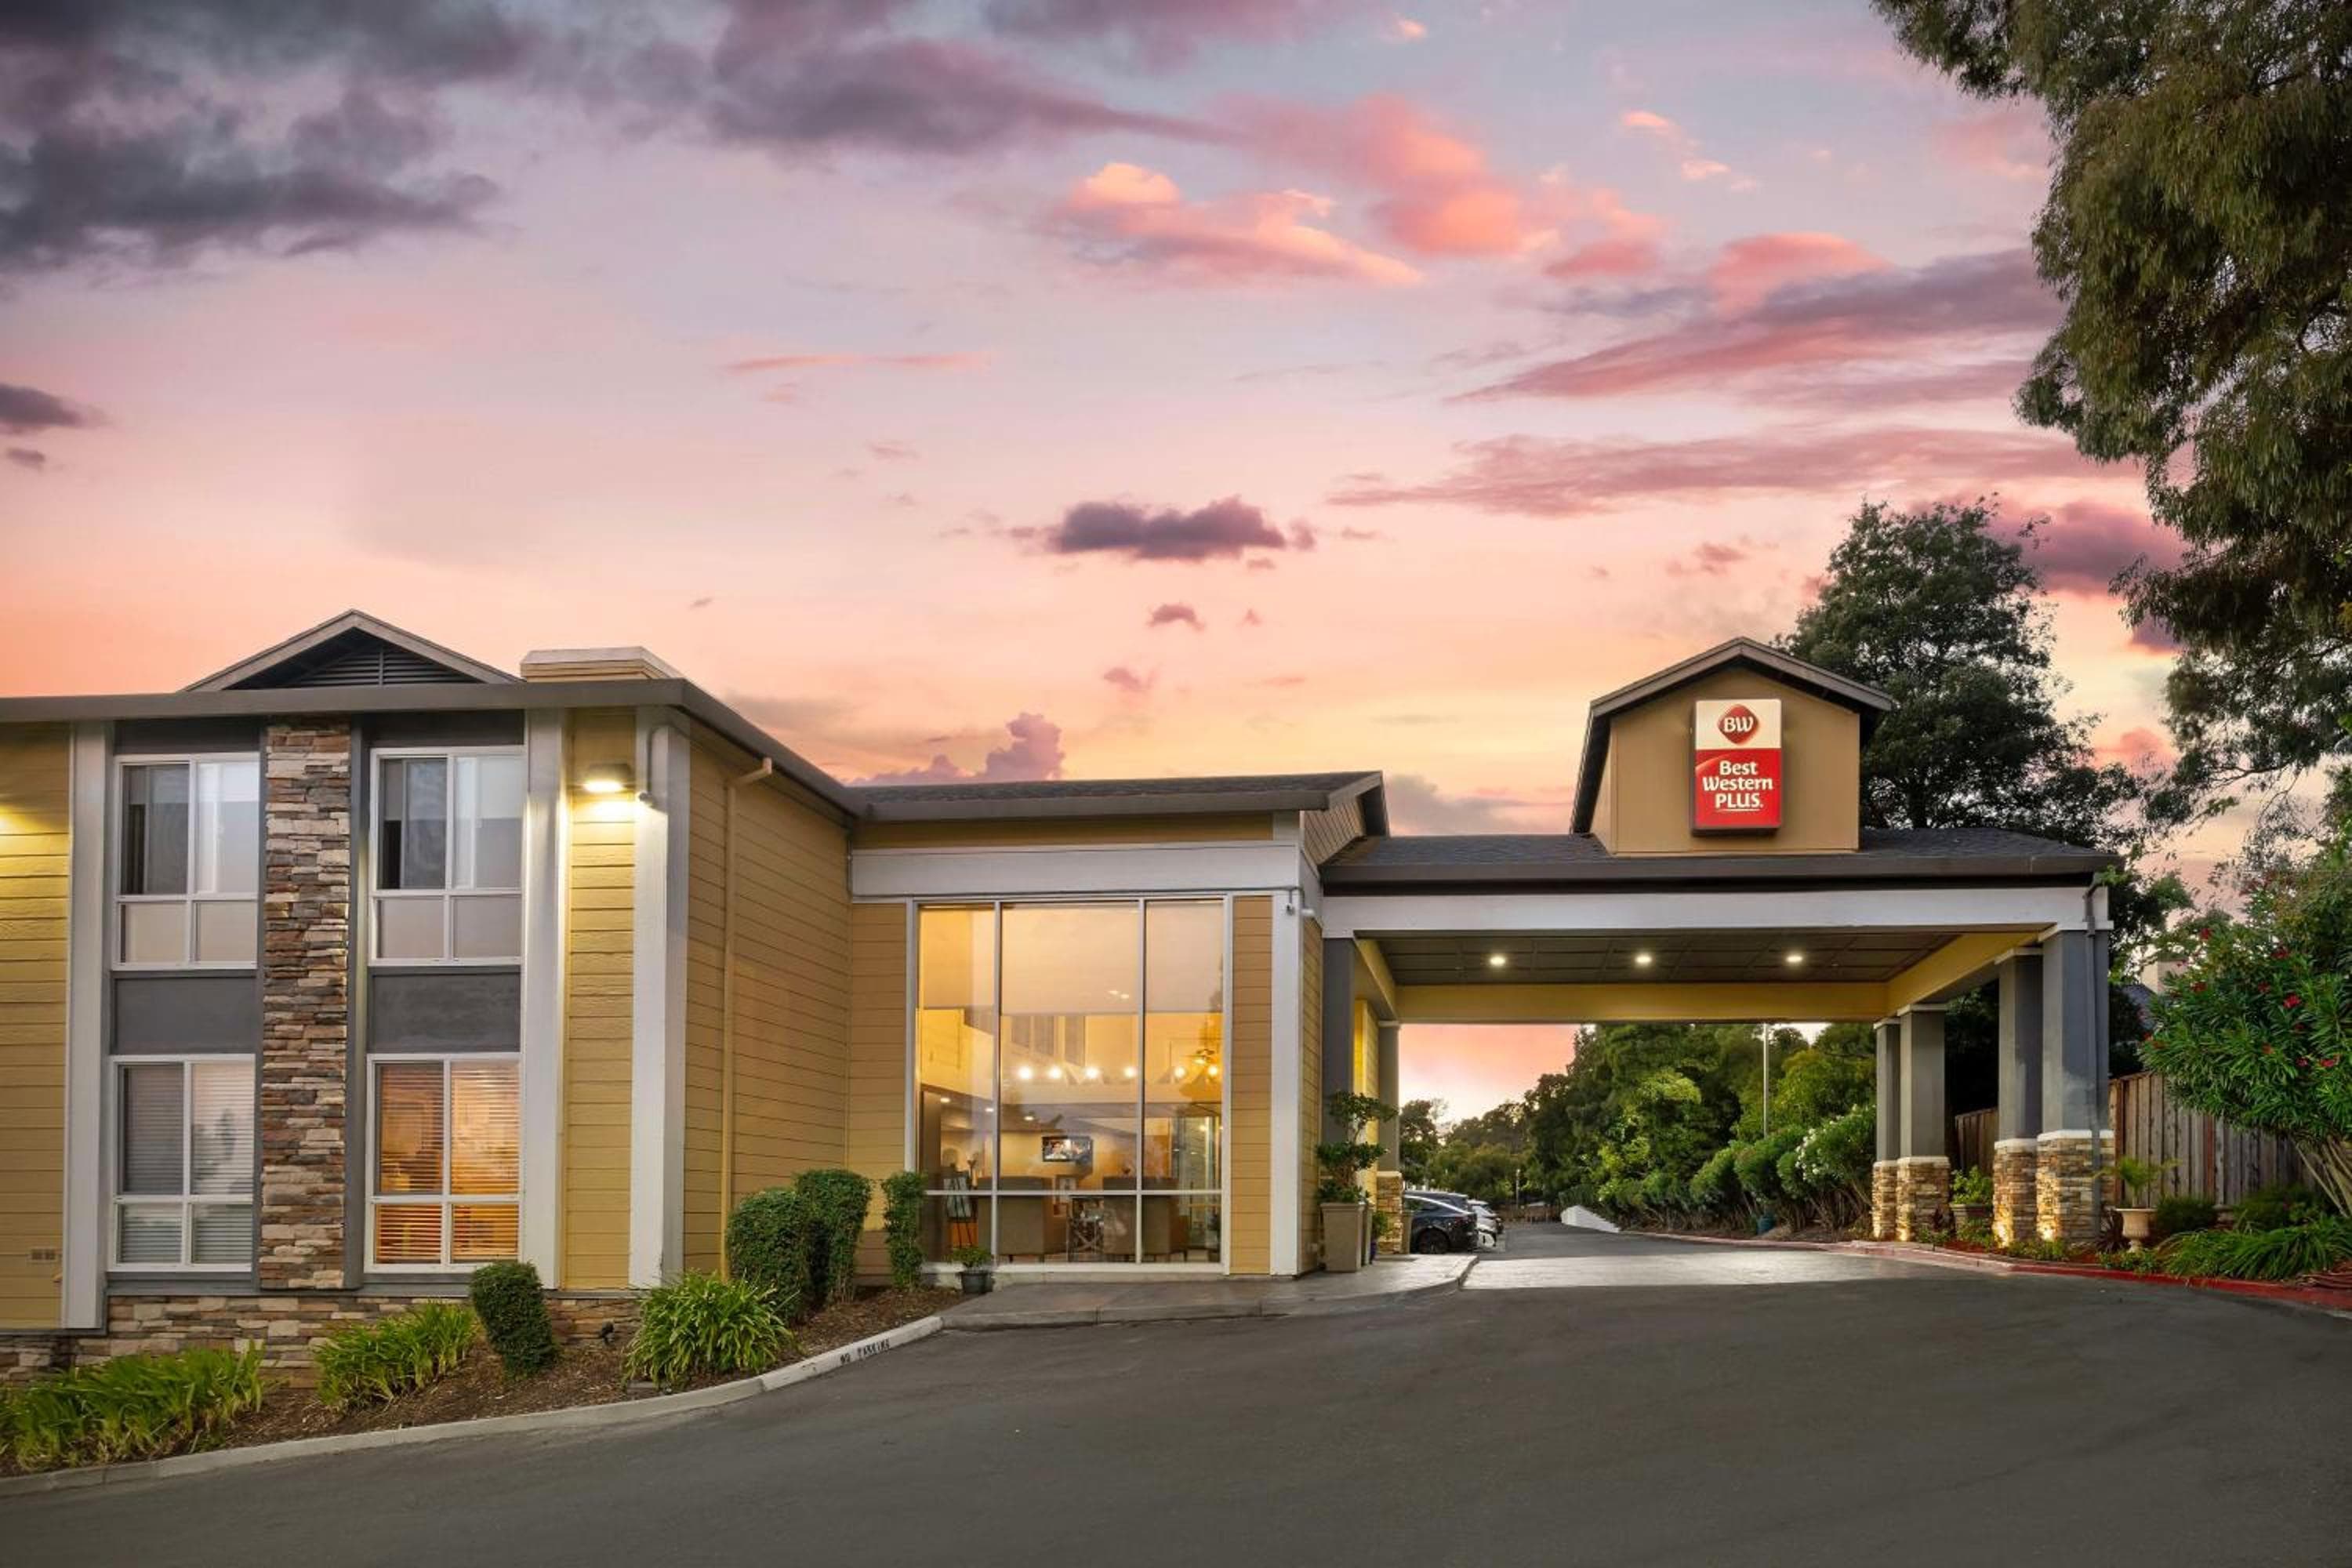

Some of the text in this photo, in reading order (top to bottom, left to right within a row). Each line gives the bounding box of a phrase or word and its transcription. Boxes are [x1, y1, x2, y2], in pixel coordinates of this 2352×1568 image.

[1723, 717, 1754, 732] BW
[1719, 760, 1759, 775] Best
[1702, 776, 1773, 791] Western
